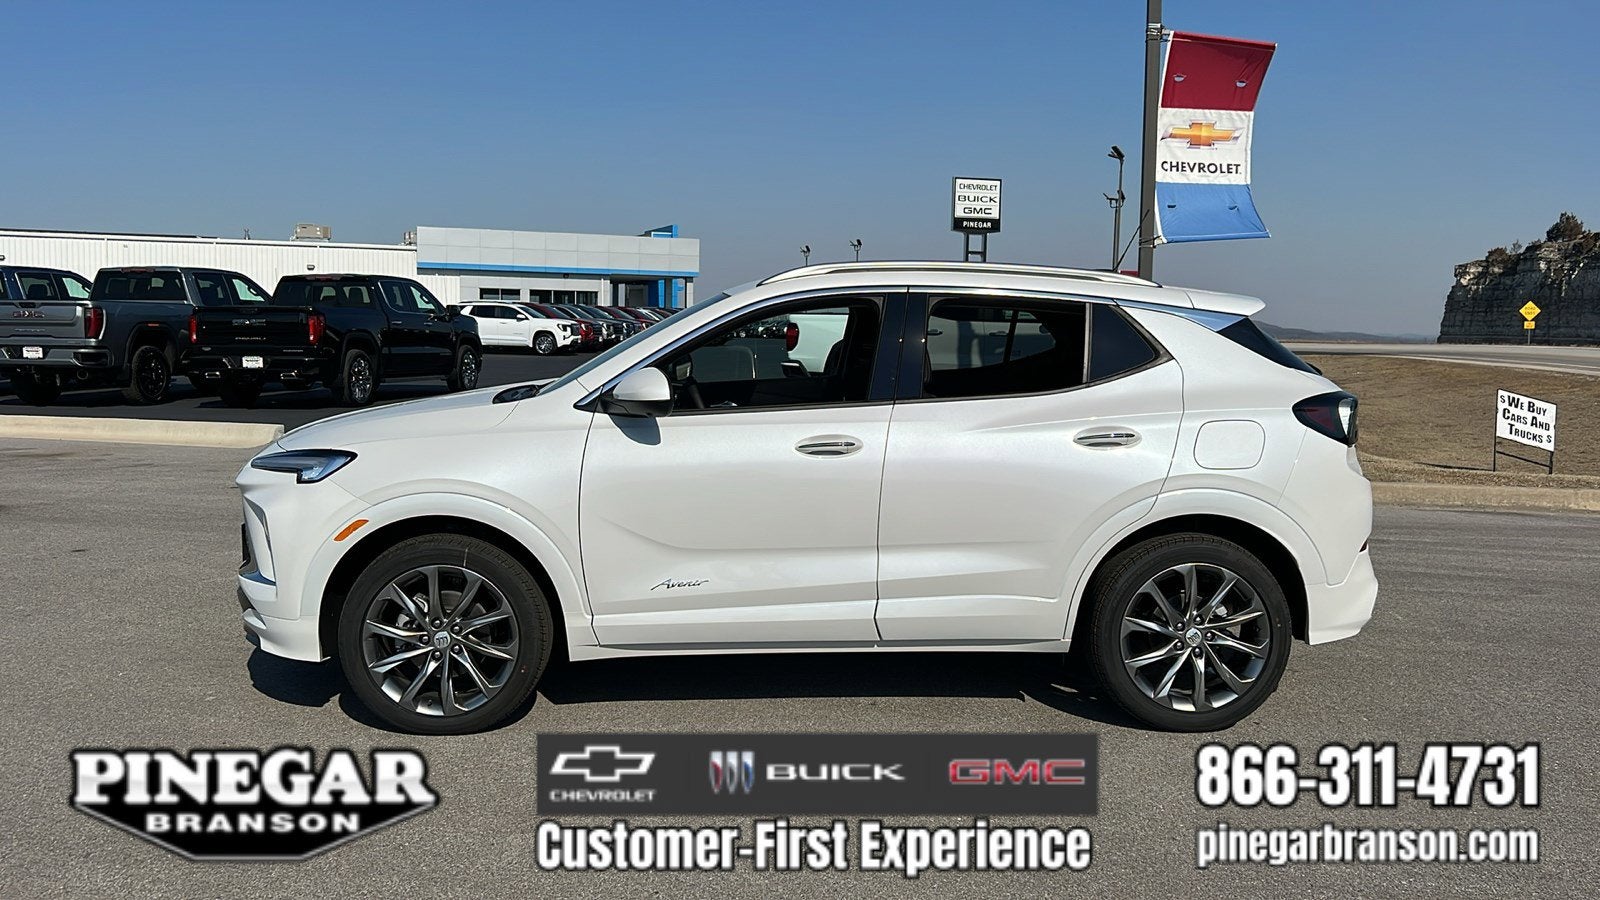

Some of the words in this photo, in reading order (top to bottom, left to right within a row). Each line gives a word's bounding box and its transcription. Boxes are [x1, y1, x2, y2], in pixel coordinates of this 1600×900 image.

[1161, 160, 1240, 175] CHEVROLET
[959, 183, 997, 191] CHEVROLET
[958, 194, 997, 203] BUICK
[963, 207, 992, 215] GMC
[650, 578, 709, 591] Avenir
